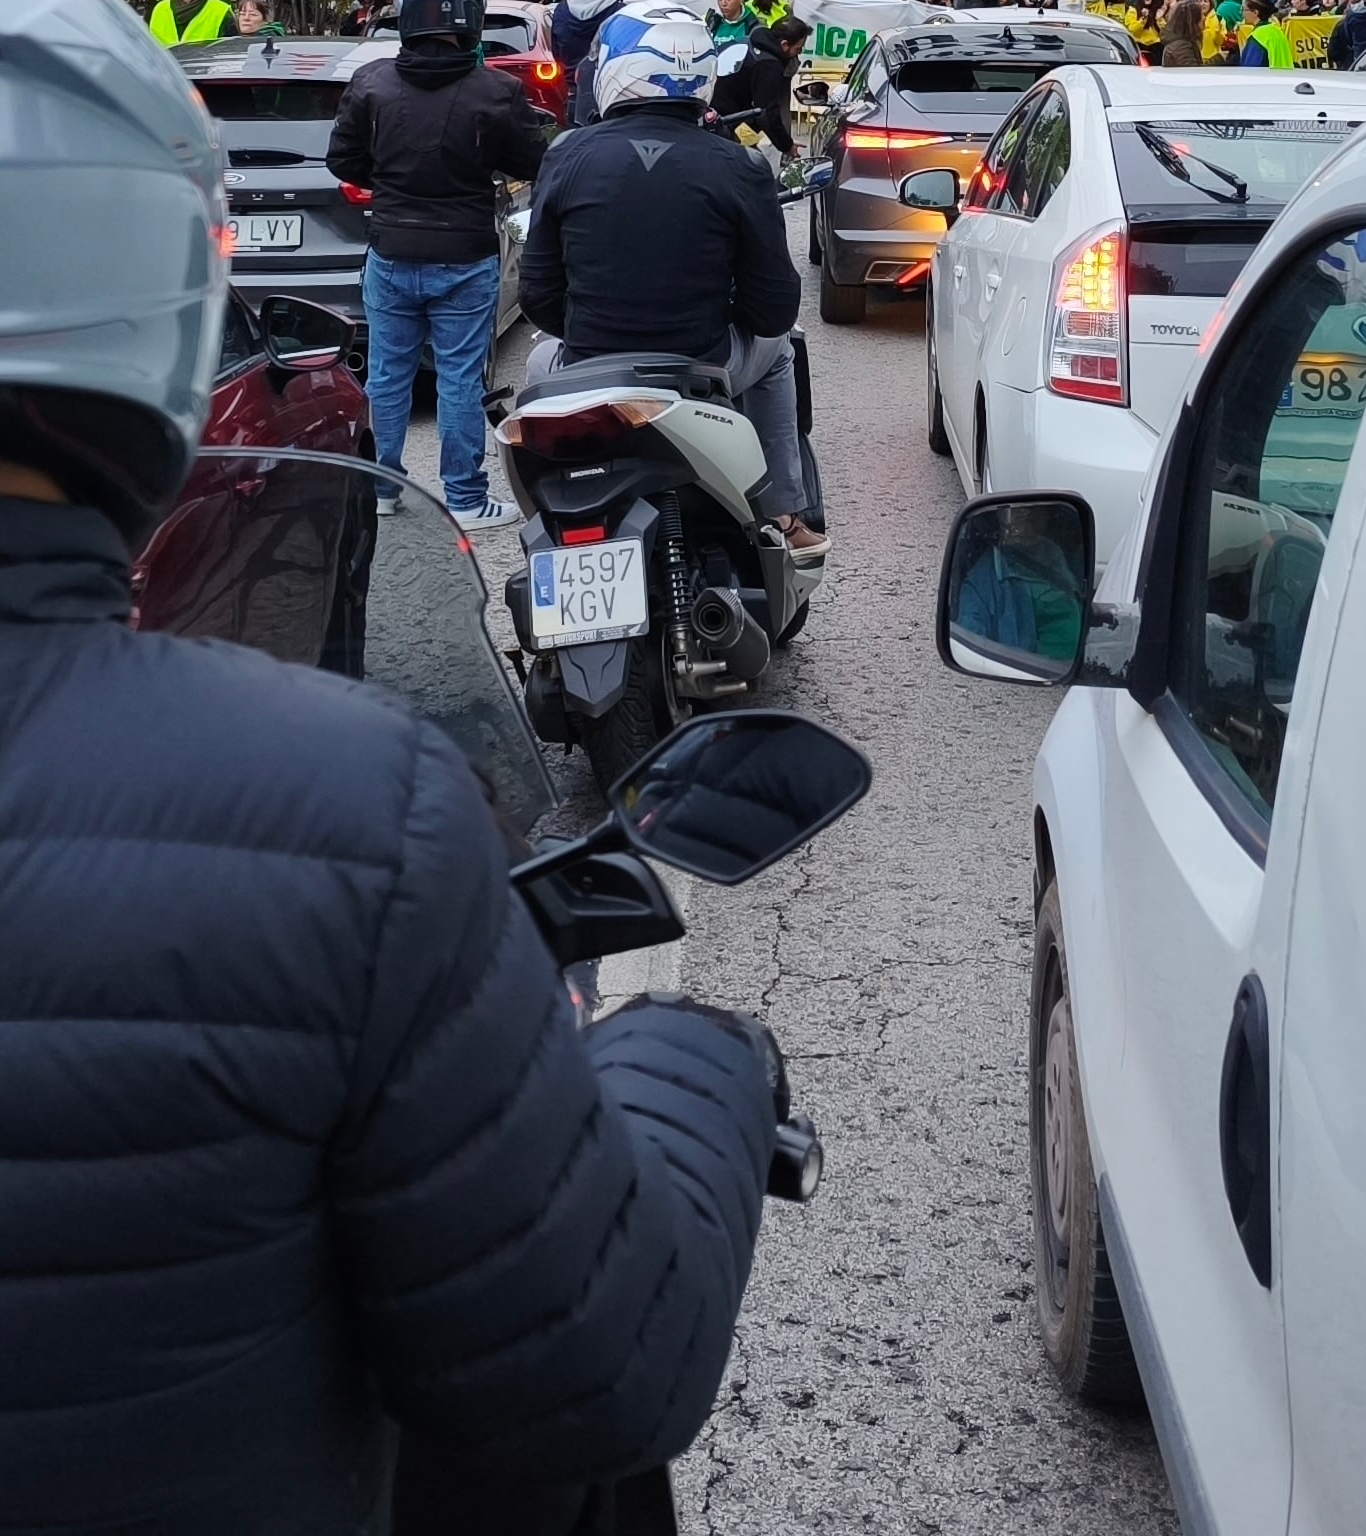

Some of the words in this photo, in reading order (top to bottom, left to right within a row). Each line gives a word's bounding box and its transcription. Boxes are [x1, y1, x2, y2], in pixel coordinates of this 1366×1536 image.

[803, 22, 867, 59] ICA
[1295, 38, 1315, 53] SU
[249, 219, 295, 241] LVY
[1150, 324, 1200, 337] TOYOTA
[559, 547, 635, 588] 4597
[540, 585, 549, 598] E
[560, 587, 616, 625] KGV
